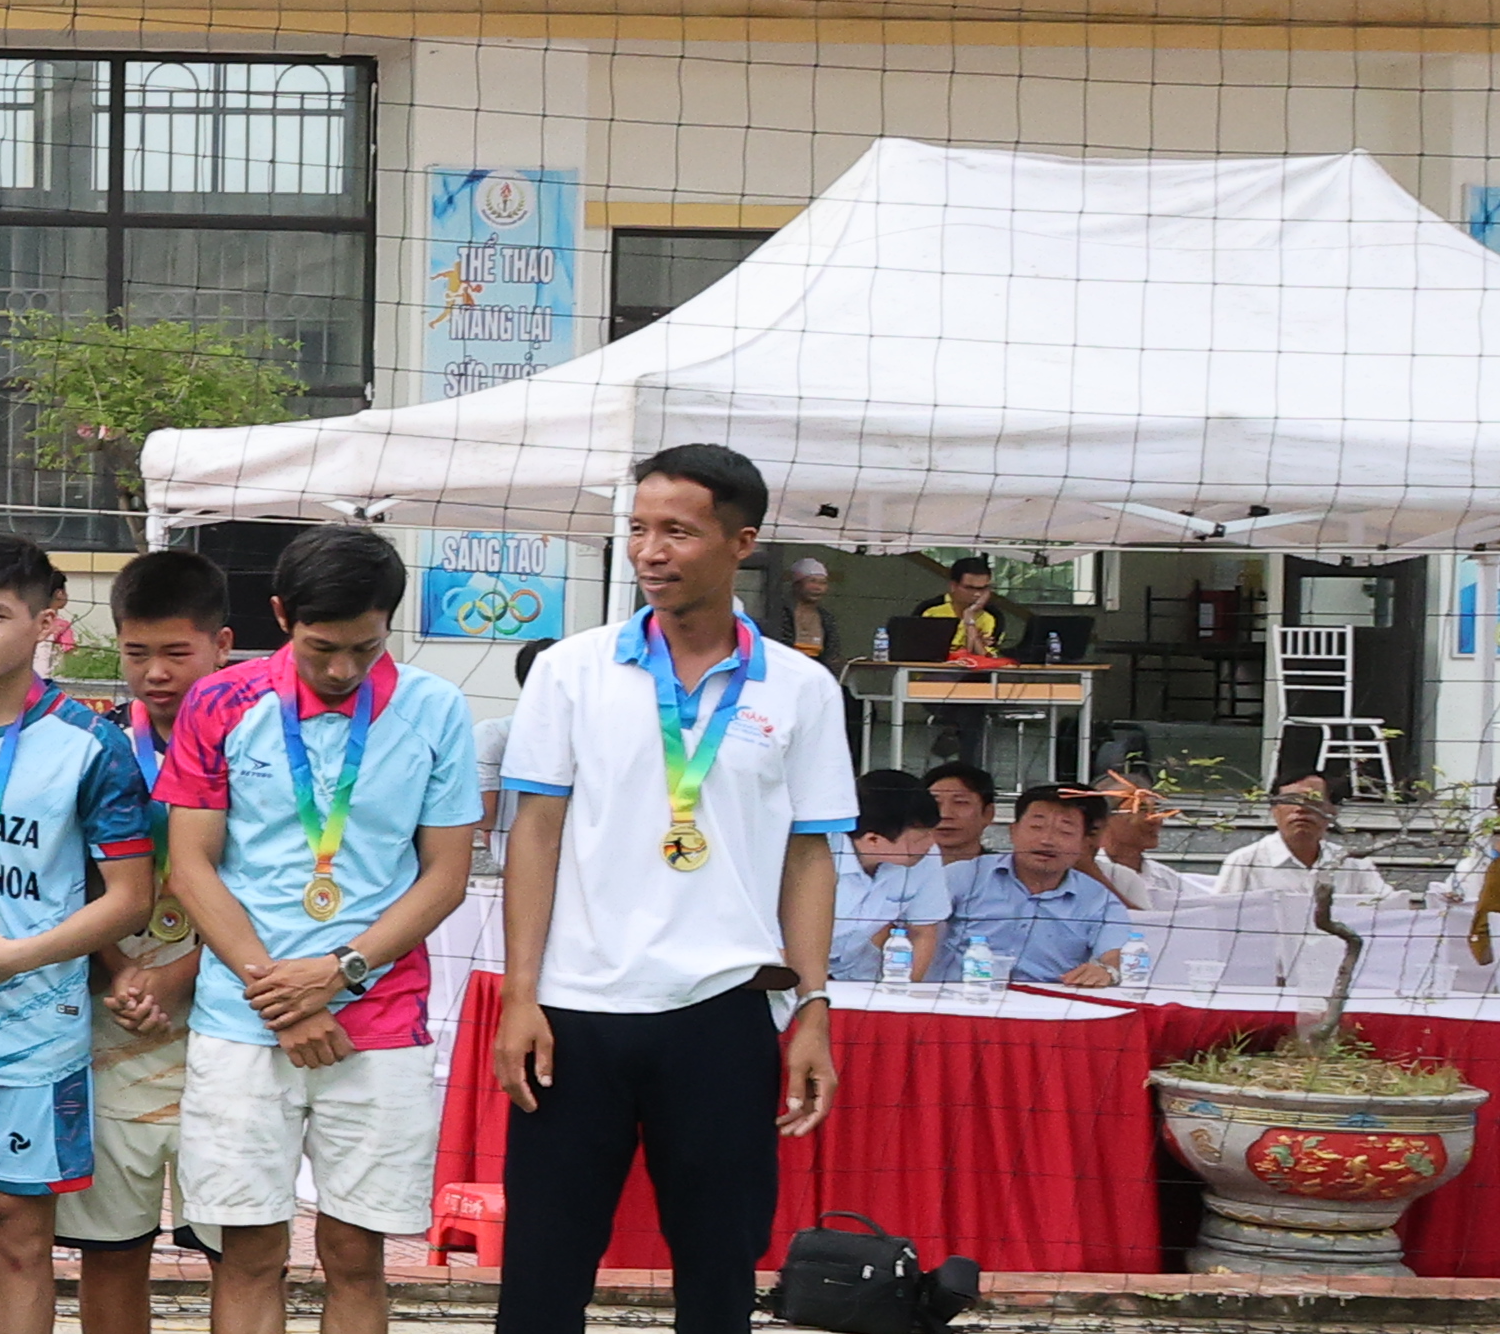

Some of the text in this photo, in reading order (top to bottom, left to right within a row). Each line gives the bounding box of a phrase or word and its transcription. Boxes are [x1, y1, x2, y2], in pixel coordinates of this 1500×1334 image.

[458, 232, 555, 284] THỂ THAO
[450, 304, 552, 349] MANG LẠI
[443, 531, 546, 582] SÁNG TẠO
